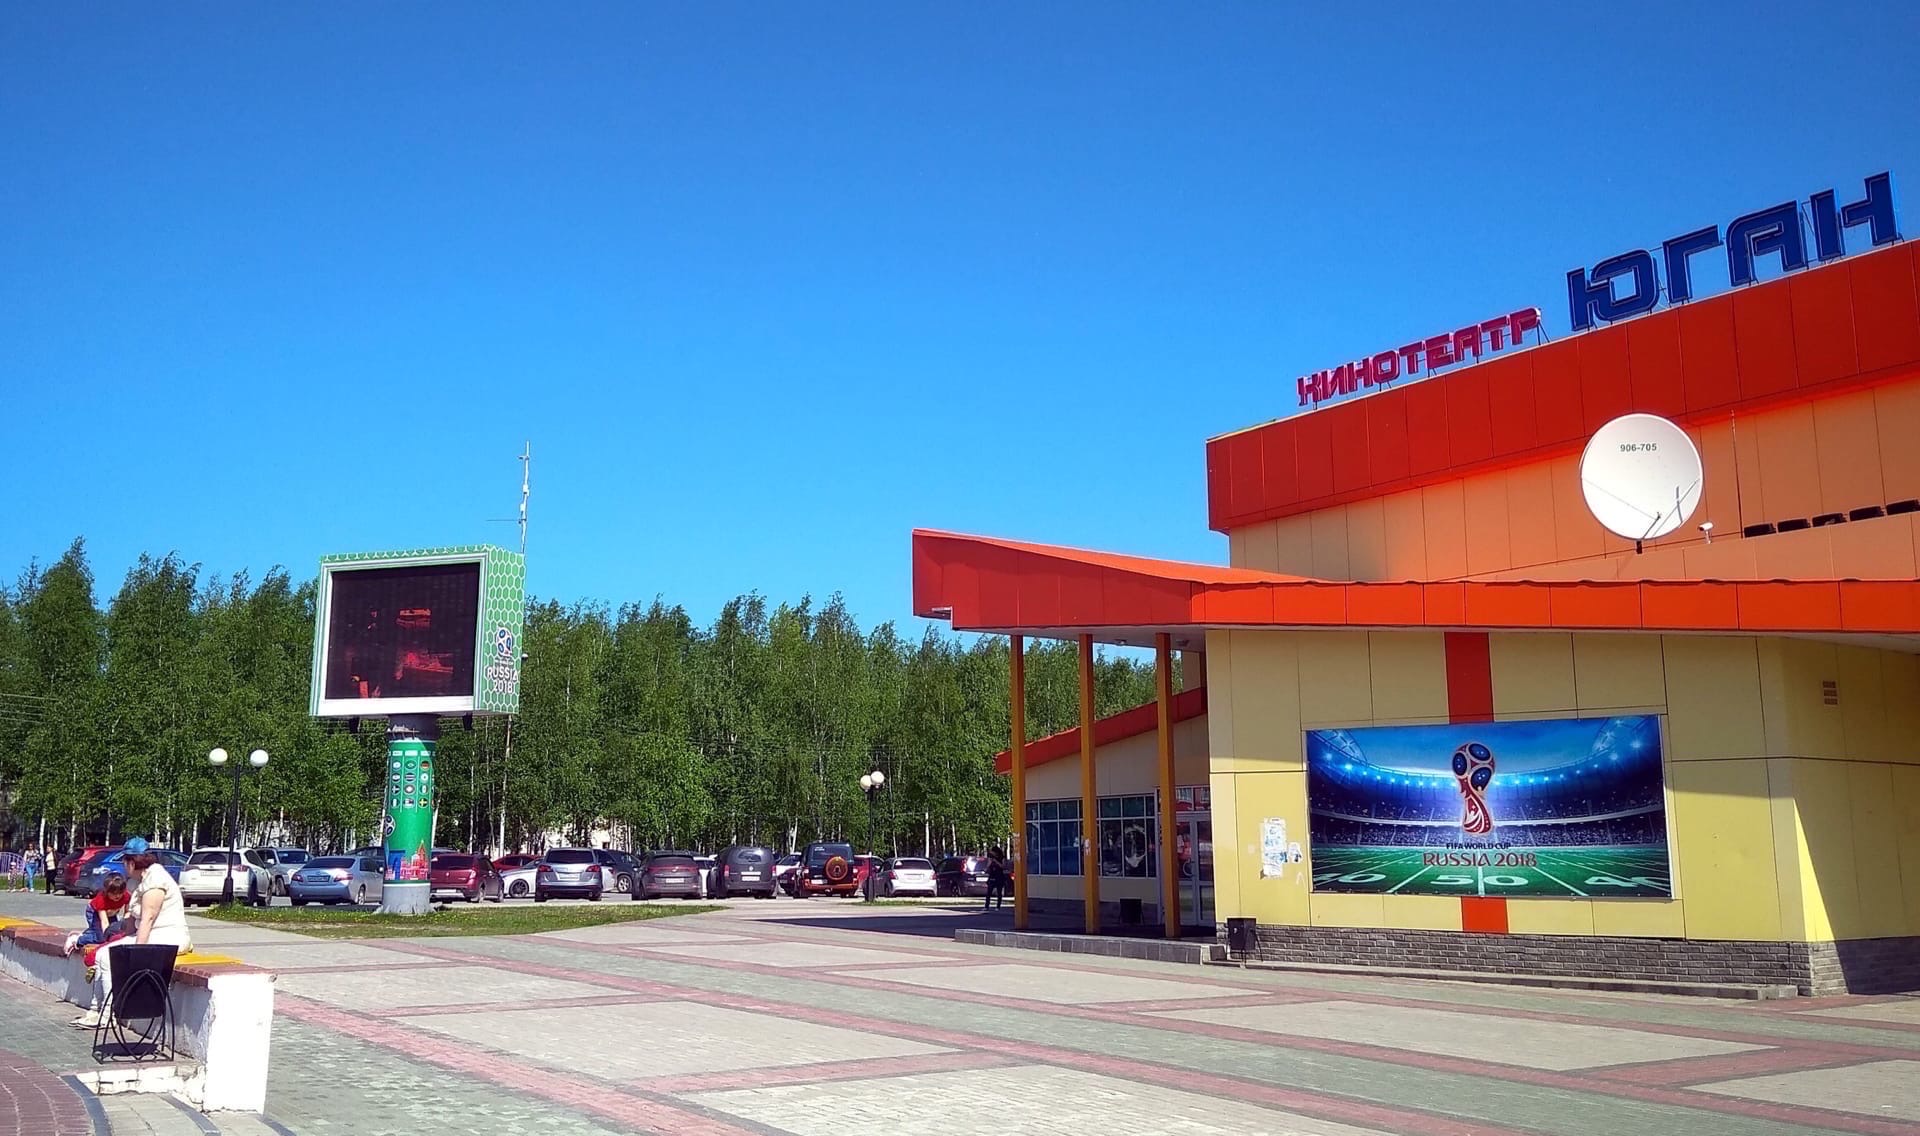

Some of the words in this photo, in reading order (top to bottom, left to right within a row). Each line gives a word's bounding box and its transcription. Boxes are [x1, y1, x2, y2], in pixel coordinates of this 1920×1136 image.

[1567, 170, 1899, 331] ЮГАН
[1297, 308, 1541, 406] КИНОТЕАТР
[1620, 443, 1656, 452] 906-705
[487, 666, 518, 681] RUSSIA
[494, 680, 513, 693] 2018
[1423, 852, 1491, 867] RUSSIA
[1494, 852, 1537, 867] 2018
[1430, 875, 1529, 886] 50
